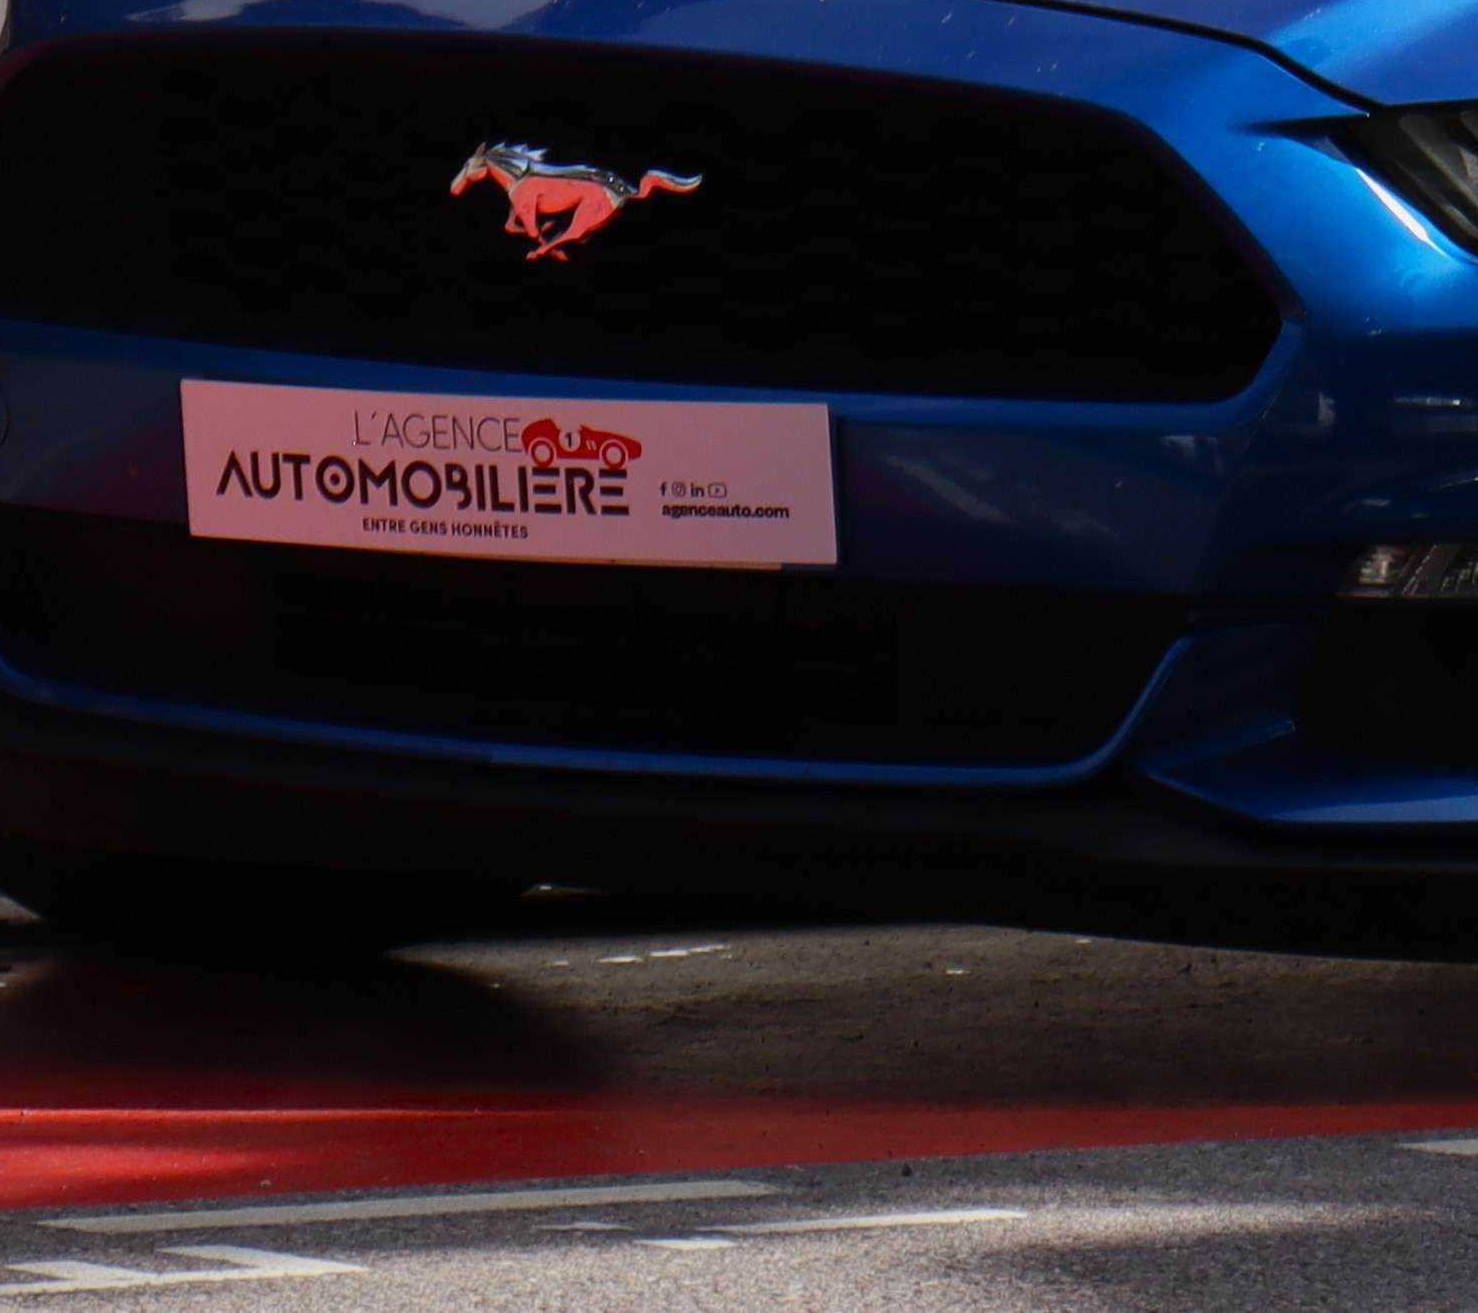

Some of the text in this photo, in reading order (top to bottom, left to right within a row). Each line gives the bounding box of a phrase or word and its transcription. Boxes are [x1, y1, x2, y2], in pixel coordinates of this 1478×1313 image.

[353, 409, 521, 453] L'AGENCE
[662, 503, 789, 518] agenceauto.com
[362, 518, 528, 540] ENTRE GENS HONNÊTES
